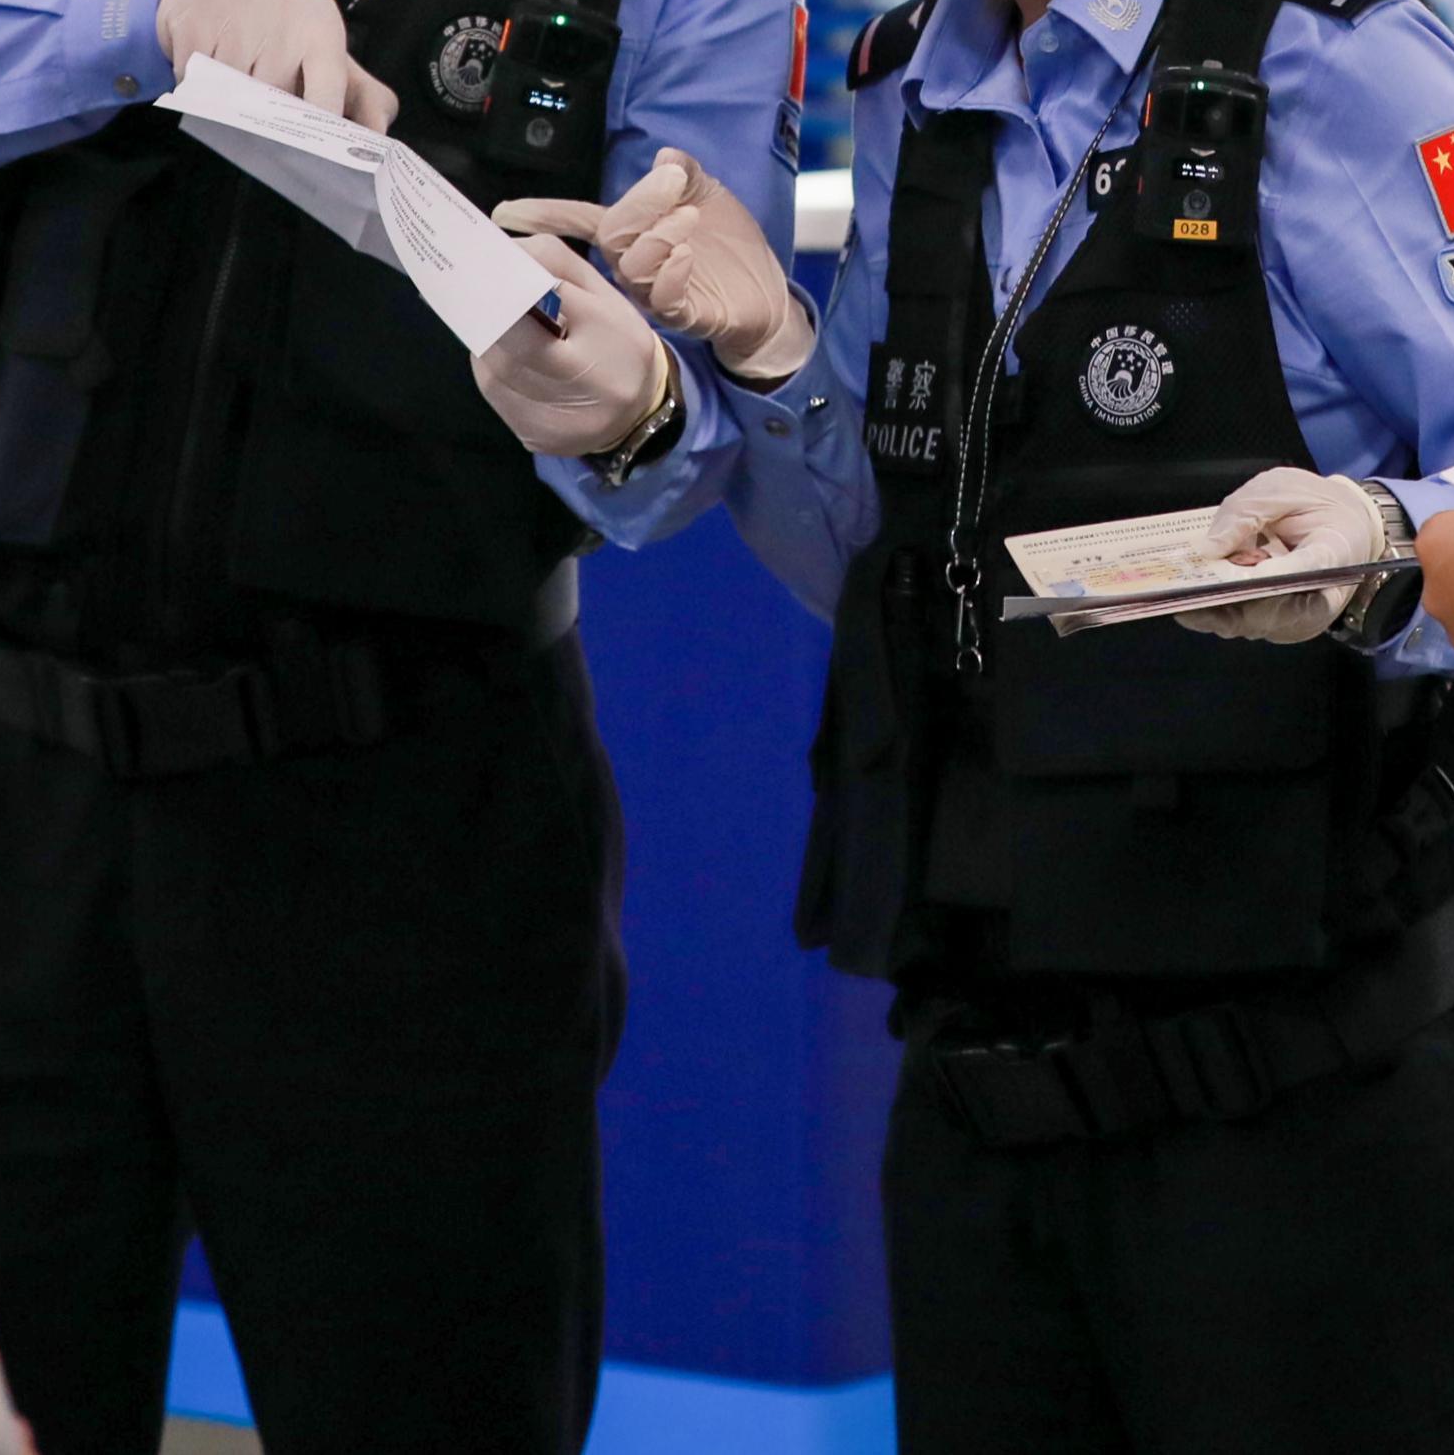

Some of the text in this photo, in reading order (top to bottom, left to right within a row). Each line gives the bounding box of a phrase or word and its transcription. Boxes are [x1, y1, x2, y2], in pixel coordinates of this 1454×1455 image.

[1179, 222, 1210, 236] 028
[885, 357, 937, 410] 警察
[1078, 374, 1162, 426] CHINA IMMIGRATION
[867, 422, 942, 461] POLICE
